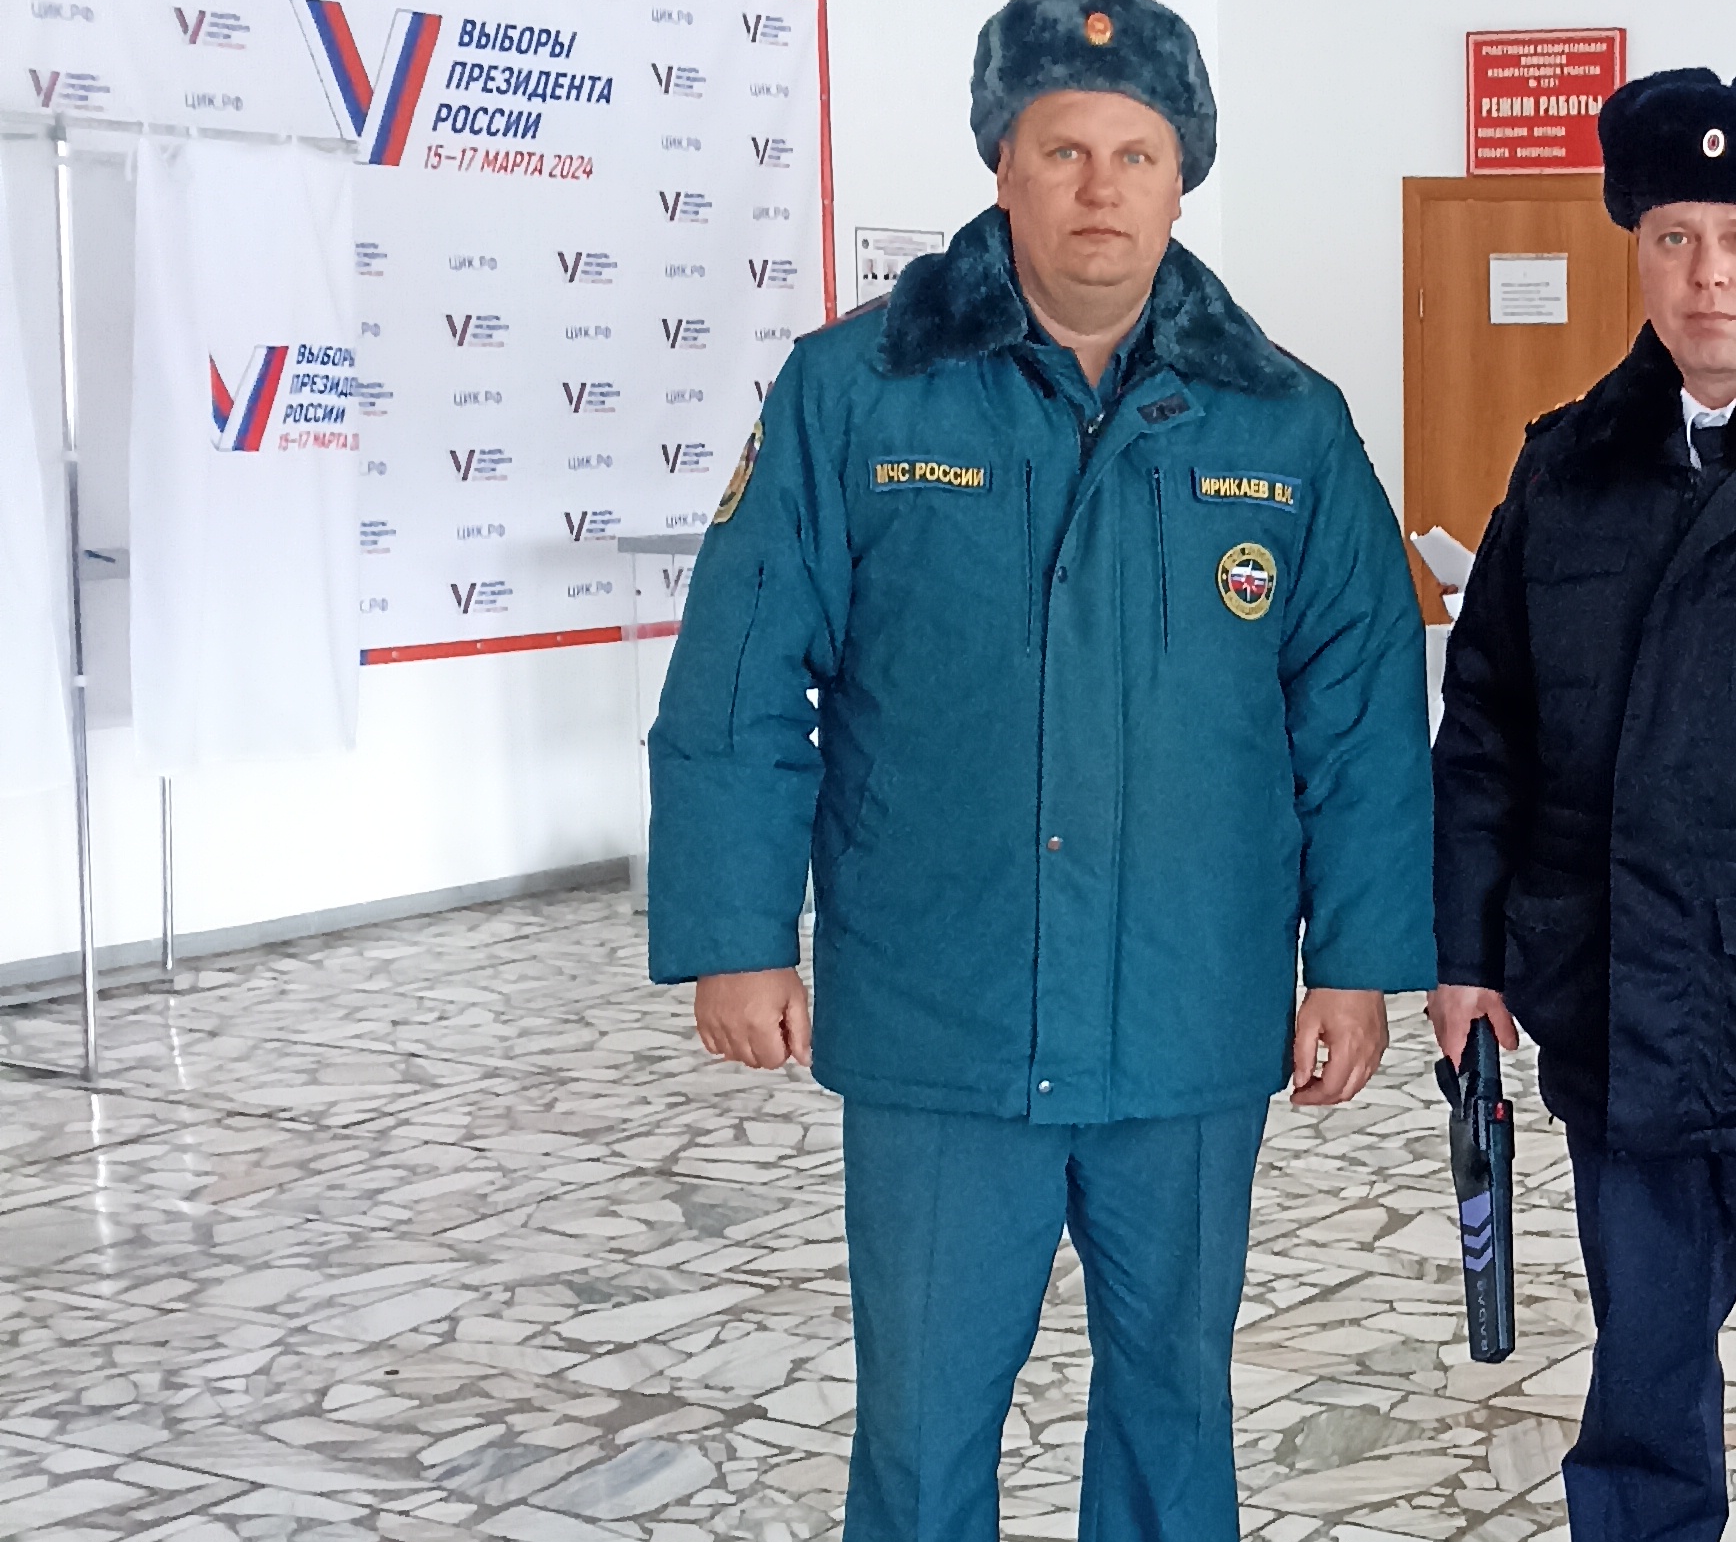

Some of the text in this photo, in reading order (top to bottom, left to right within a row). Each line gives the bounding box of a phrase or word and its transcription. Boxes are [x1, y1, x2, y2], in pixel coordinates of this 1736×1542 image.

[457, 18, 577, 59] ВЫБОРЫ
[446, 61, 613, 104] ПРЕЗИДЕНТА
[1481, 95, 1603, 117] РЕЖИМ РАБОТЫ
[432, 104, 542, 139] РОССИИ
[481, 149, 545, 177] МАРТА
[549, 154, 594, 180] 2024
[283, 402, 346, 425] РОССИИ
[875, 462, 985, 487] МЧС РОССИИ
[1201, 477, 1269, 498] ИРИКАЕВ
